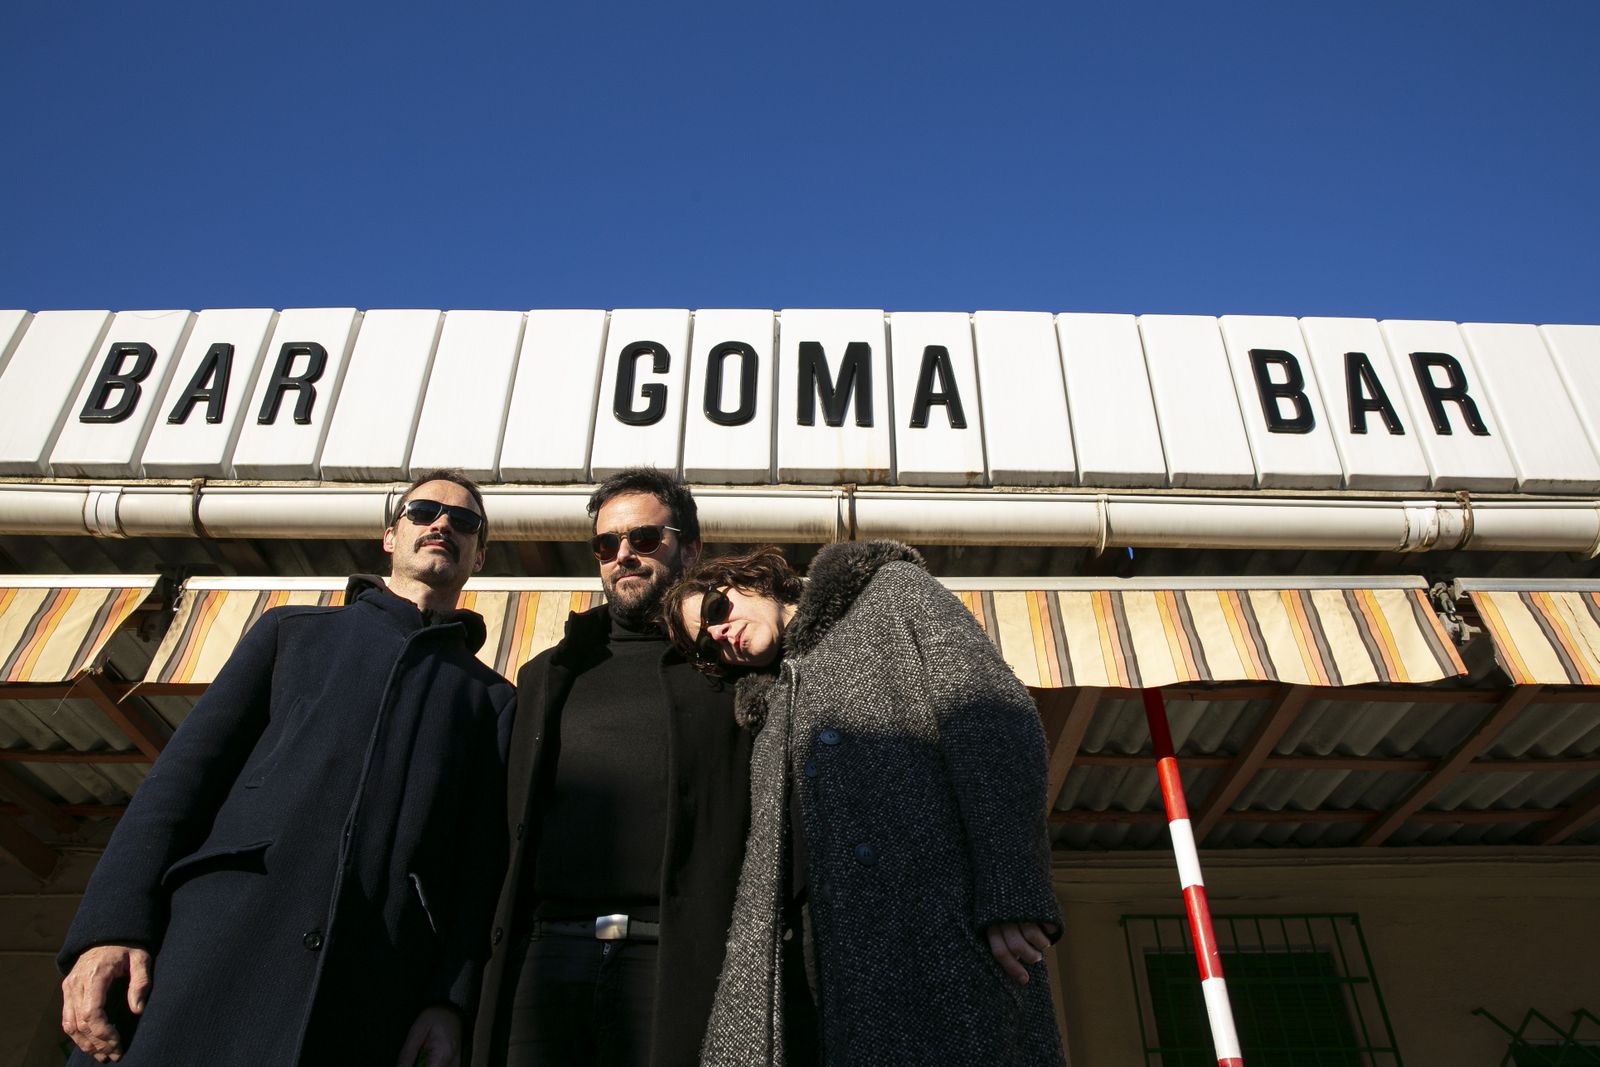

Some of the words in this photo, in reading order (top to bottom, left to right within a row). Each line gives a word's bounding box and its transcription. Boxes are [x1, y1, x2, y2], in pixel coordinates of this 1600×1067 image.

[80, 342, 328, 426] BAR
[613, 341, 968, 430] GOMA
[1249, 349, 1491, 437] BAR
